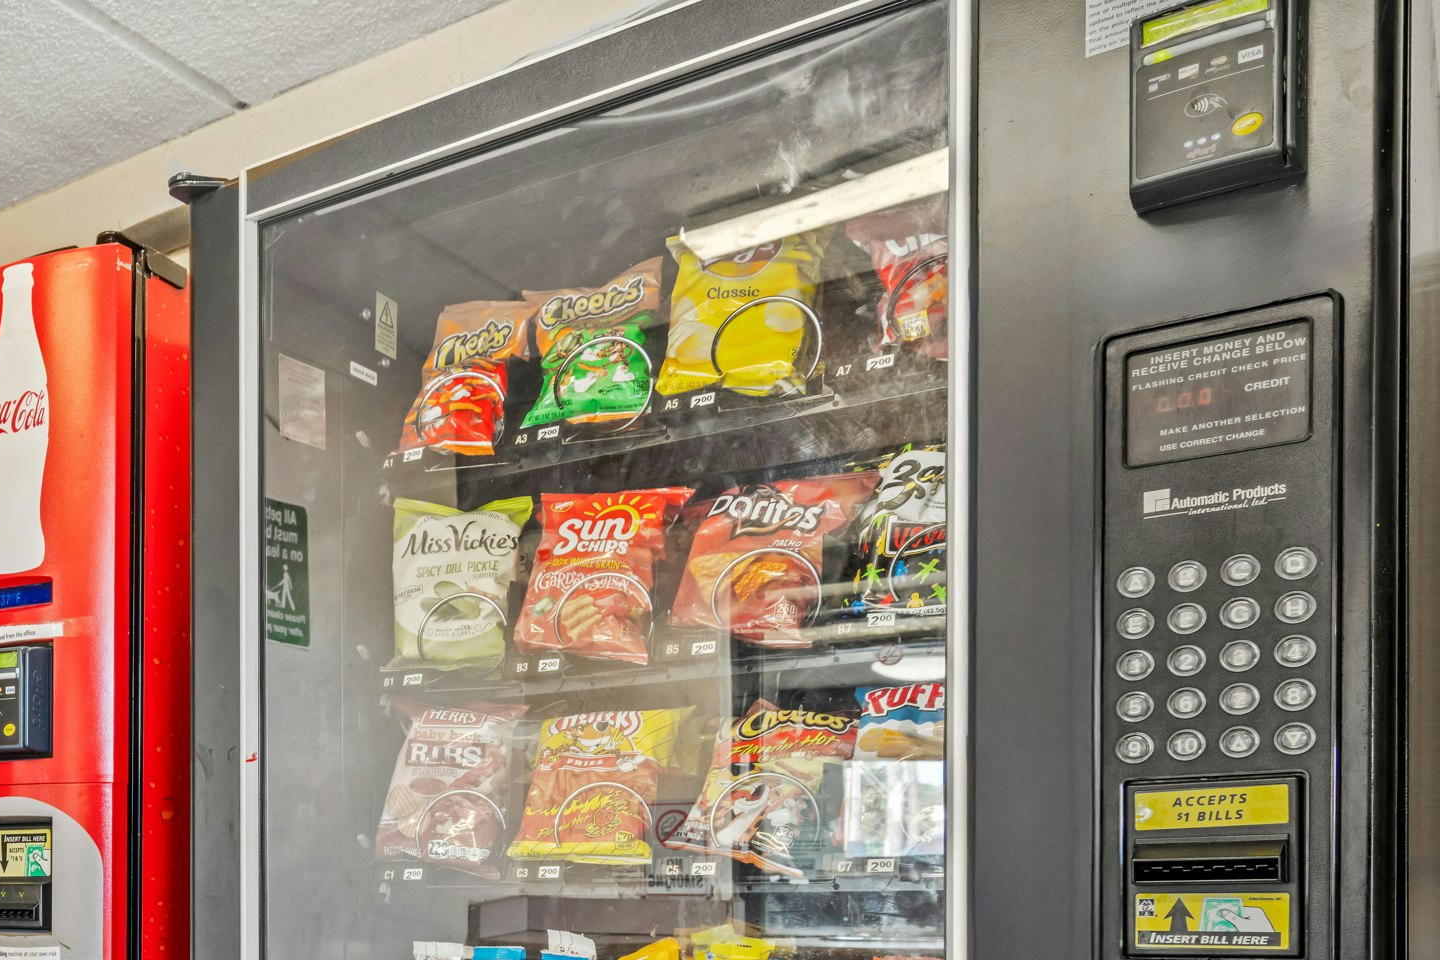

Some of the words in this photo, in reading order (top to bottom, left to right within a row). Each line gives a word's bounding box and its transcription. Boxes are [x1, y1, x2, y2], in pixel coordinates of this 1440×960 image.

[1089, 14, 1114, 27] updated
[1125, 6, 1144, 15] reflect
[1241, 49, 1262, 59] VISA
[707, 286, 760, 301] Classic
[539, 276, 645, 330] Cheetos
[433, 323, 513, 369] Cheetos
[1150, 348, 1199, 365] INSERT
[1203, 337, 1252, 356] MONEY
[1256, 331, 1286, 346] AND
[1131, 360, 1188, 378] RECEIVE
[1193, 348, 1250, 366] CHANGE
[1255, 337, 1307, 354] BELOW
[836, 365, 852, 377] A7
[1132, 376, 1184, 392] FLASHING
[1188, 368, 1227, 382] CREDIT
[1231, 360, 1269, 373] CHECK
[1273, 352, 1307, 365] PRICE
[1244, 377, 1290, 392] CREDIT
[665, 398, 679, 410] A5
[1160, 424, 1188, 436] MAKE
[1191, 416, 1241, 431] ANOTHER
[1244, 405, 1306, 423] SELECTION
[515, 434, 528, 445] A3
[1160, 441, 1178, 452] USE
[1180, 435, 1224, 449] CORRECT
[1225, 428, 1265, 441] CHANGE
[383, 459, 394, 469] A1
[1171, 491, 1229, 510] Automatic
[1233, 483, 1286, 502] Products
[706, 494, 824, 530] Doritos
[401, 530, 451, 559] Miss
[446, 521, 521, 557] Vickie's
[553, 516, 636, 555] Sun
[577, 540, 629, 555] CHIPS
[772, 539, 803, 548] NACHO
[416, 565, 442, 578] SPICY
[445, 563, 463, 575] DILL
[467, 560, 499, 573] PICKLE
[595, 559, 621, 570] GRAIN
[837, 624, 852, 635] B7
[666, 645, 679, 655] B5
[516, 662, 528, 672] B3
[1180, 655, 1193, 670] 2
[384, 678, 394, 687] B1
[1129, 701, 1141, 714] 5
[414, 729, 446, 741] baby
[799, 731, 838, 748] Hot
[1128, 742, 1140, 756] 9
[1176, 738, 1198, 753] 10
[408, 742, 482, 768] RIBS
[566, 758, 604, 768] FRIES
[1172, 793, 1248, 808] ACCEPTS
[1177, 812, 1190, 822] $1
[1197, 809, 1244, 822] BILLS
[4, 834, 21, 843] INSERT
[516, 867, 528, 878] C3
[666, 864, 679, 875] C5
[837, 861, 853, 873] C7
[384, 870, 394, 880] C1
[1149, 932, 1197, 944] INSERT
[1200, 933, 1230, 944] BILL
[1232, 935, 1270, 945] HERE
